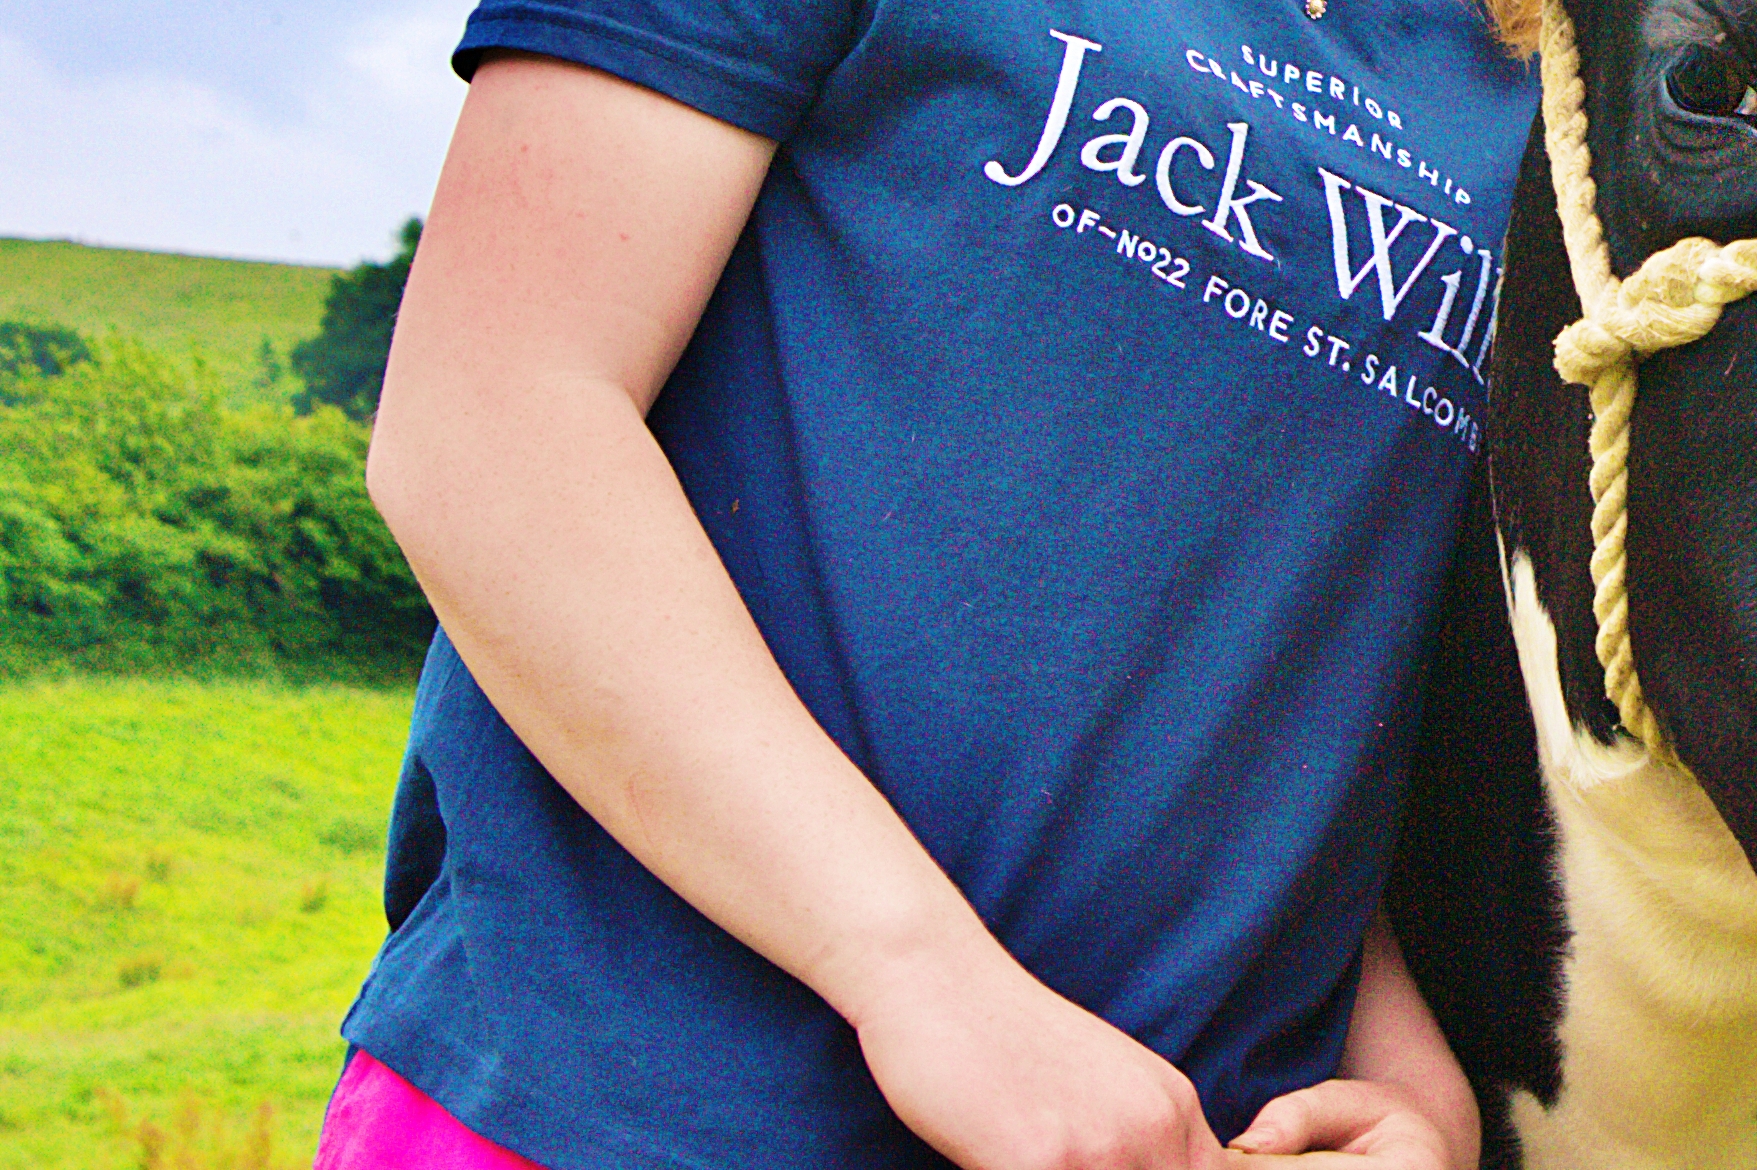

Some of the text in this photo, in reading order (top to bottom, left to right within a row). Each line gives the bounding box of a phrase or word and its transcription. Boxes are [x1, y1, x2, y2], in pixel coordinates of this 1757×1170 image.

[983, 28, 1283, 261] Jack
[1185, 48, 1472, 205] CRAFTSMANSHIP
[1241, 44, 1404, 131] SUPERIOR
[1203, 275, 1294, 343] FORE
[1303, 325, 1350, 373] ST.
